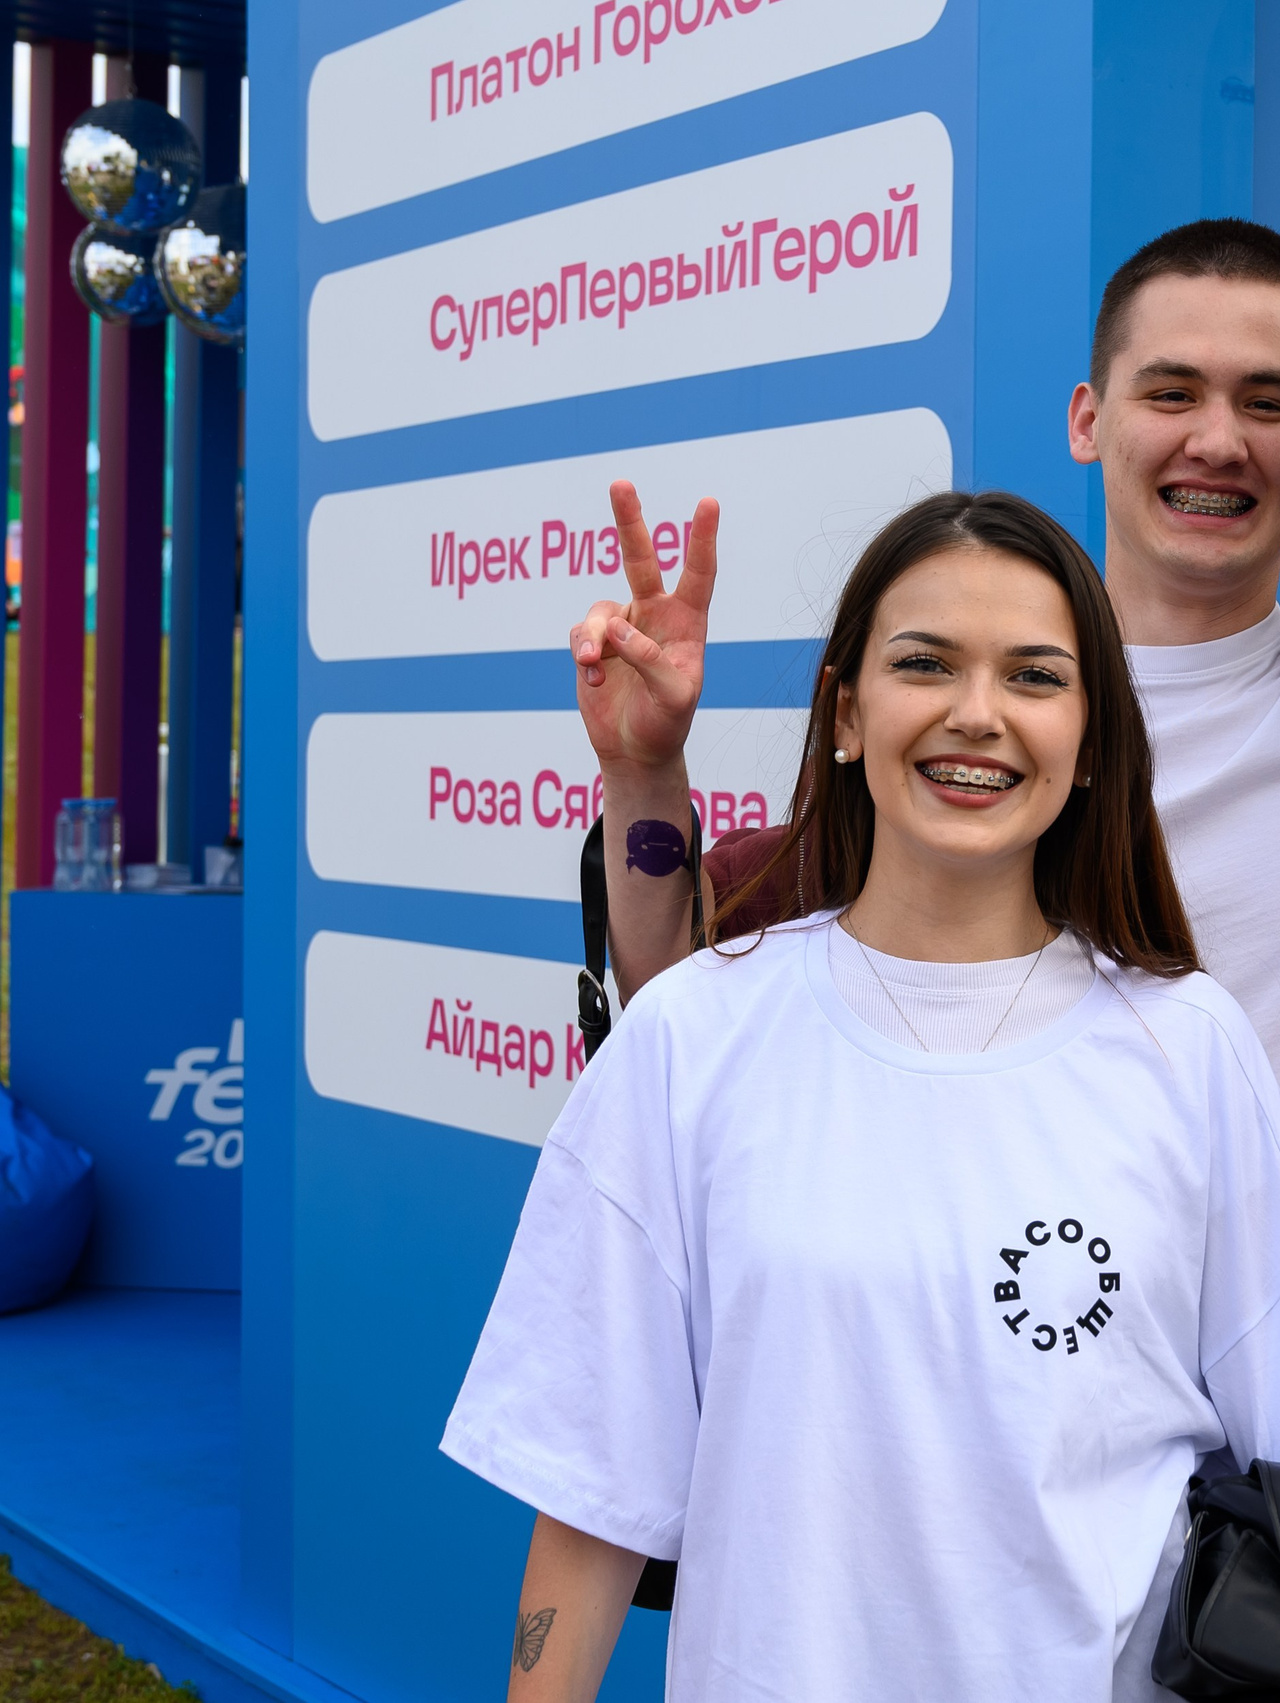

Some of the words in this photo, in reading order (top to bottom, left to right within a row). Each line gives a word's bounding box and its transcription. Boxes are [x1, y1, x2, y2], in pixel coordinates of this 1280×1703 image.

[430, 26, 581, 122] Платон
[429, 183, 920, 362] СуперПервыйГерой
[430, 530, 532, 601] Ирек
[540, 519, 694, 578] Ризе
[429, 766, 522, 827] Роза
[425, 997, 555, 1090] Айдар
[993, 1218, 1121, 1356] СООБЩЕСТВА
